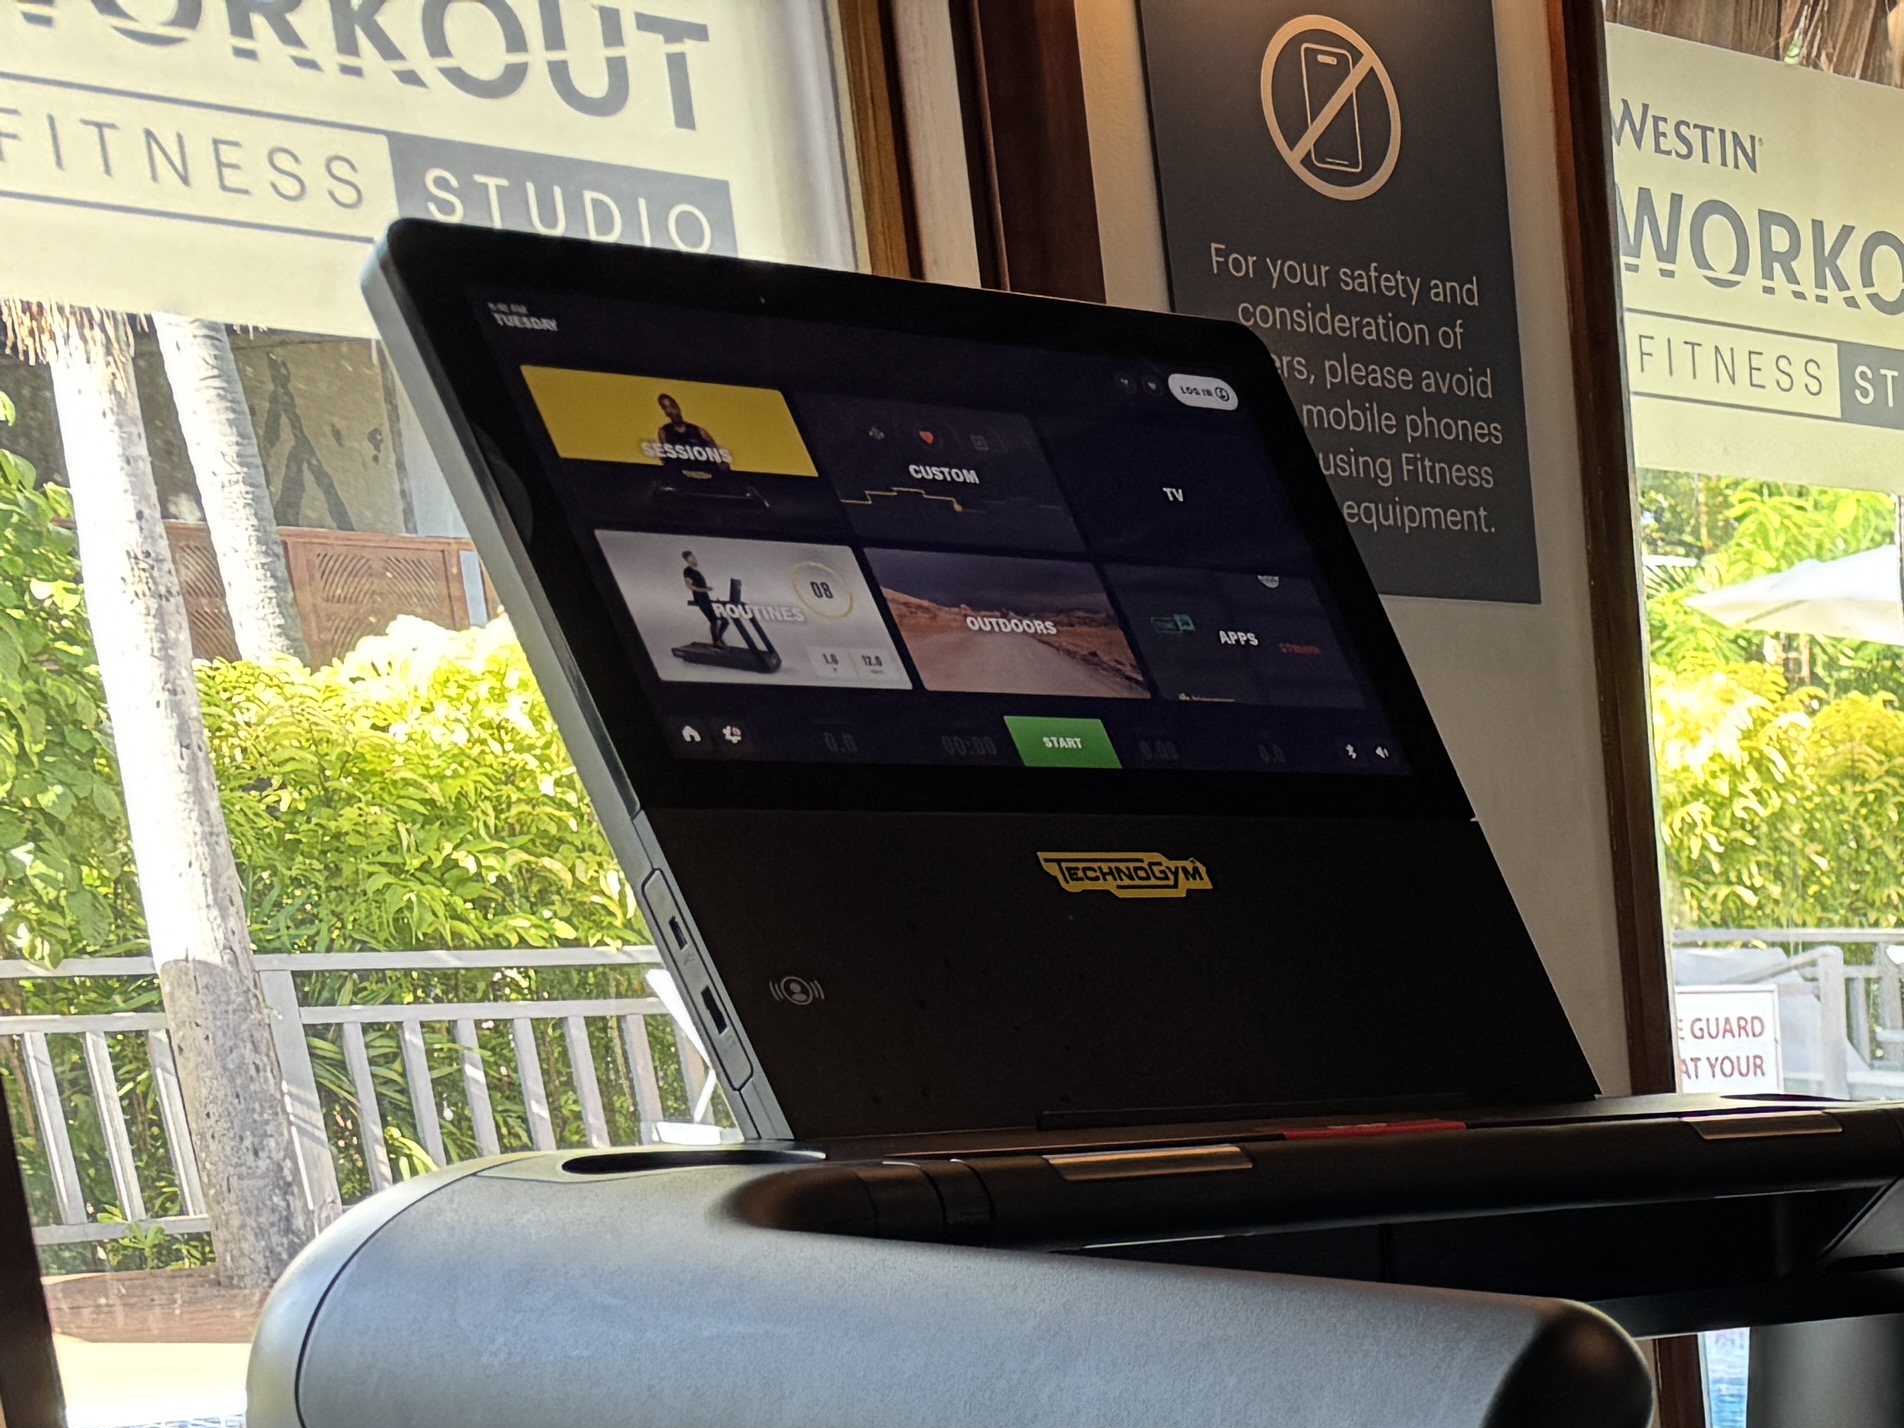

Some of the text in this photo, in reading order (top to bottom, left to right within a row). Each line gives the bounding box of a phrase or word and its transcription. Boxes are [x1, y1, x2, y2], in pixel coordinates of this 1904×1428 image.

[17, 0, 709, 131] RKOUT
[1614, 98, 1758, 173] WESTIN
[0, 106, 712, 254] FITNESS STUDIO
[1210, 242, 1479, 306] For your safety and
[1238, 301, 1464, 350] consideration of
[1271, 352, 1492, 398] ers, please avoid
[1638, 334, 1823, 397] FITNESS
[1302, 400, 1503, 444] mobile phones
[641, 441, 733, 464] SESSIONS
[909, 464, 980, 484] CUSTOM
[1318, 448, 1494, 488] using Fitness
[1163, 487, 1184, 502] TV
[1343, 498, 1496, 533] equipment.
[810, 581, 833, 600] 08
[713, 603, 804, 622] ROUTINES
[966, 615, 1057, 635] OUTDOORS
[1218, 629, 1258, 646] APPS
[1043, 736, 1083, 750] START
[1690, 1016, 1765, 1039] GUARD
[1706, 1055, 1765, 1079] YOUR
